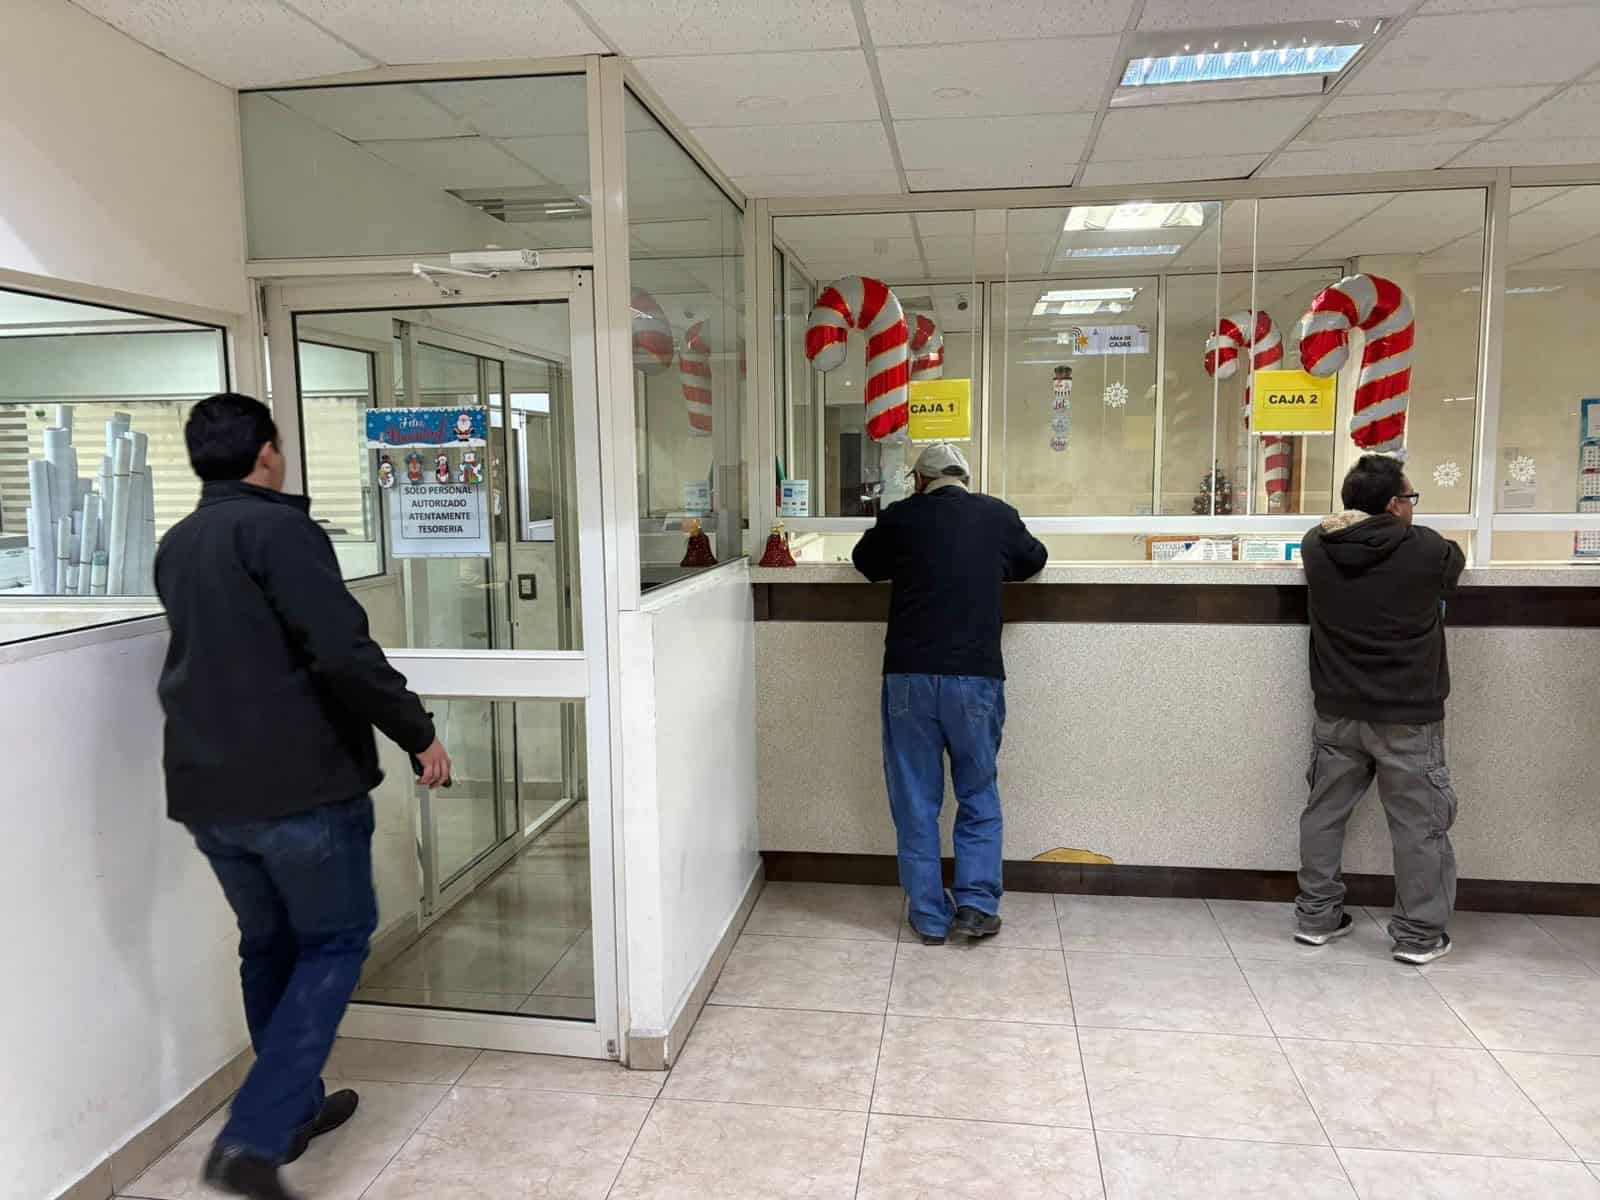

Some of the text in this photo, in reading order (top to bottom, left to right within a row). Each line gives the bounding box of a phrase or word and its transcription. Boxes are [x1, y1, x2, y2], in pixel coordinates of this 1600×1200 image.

[1269, 394, 1318, 404] CAJA 2
[911, 403, 954, 414] CAJA 1
[404, 486, 472, 495] SOLO PERSONAL
[411, 499, 467, 508] AUTORIZADO
[408, 511, 472, 520] ATENTAMENTE
[417, 525, 464, 533] TESORERIA
